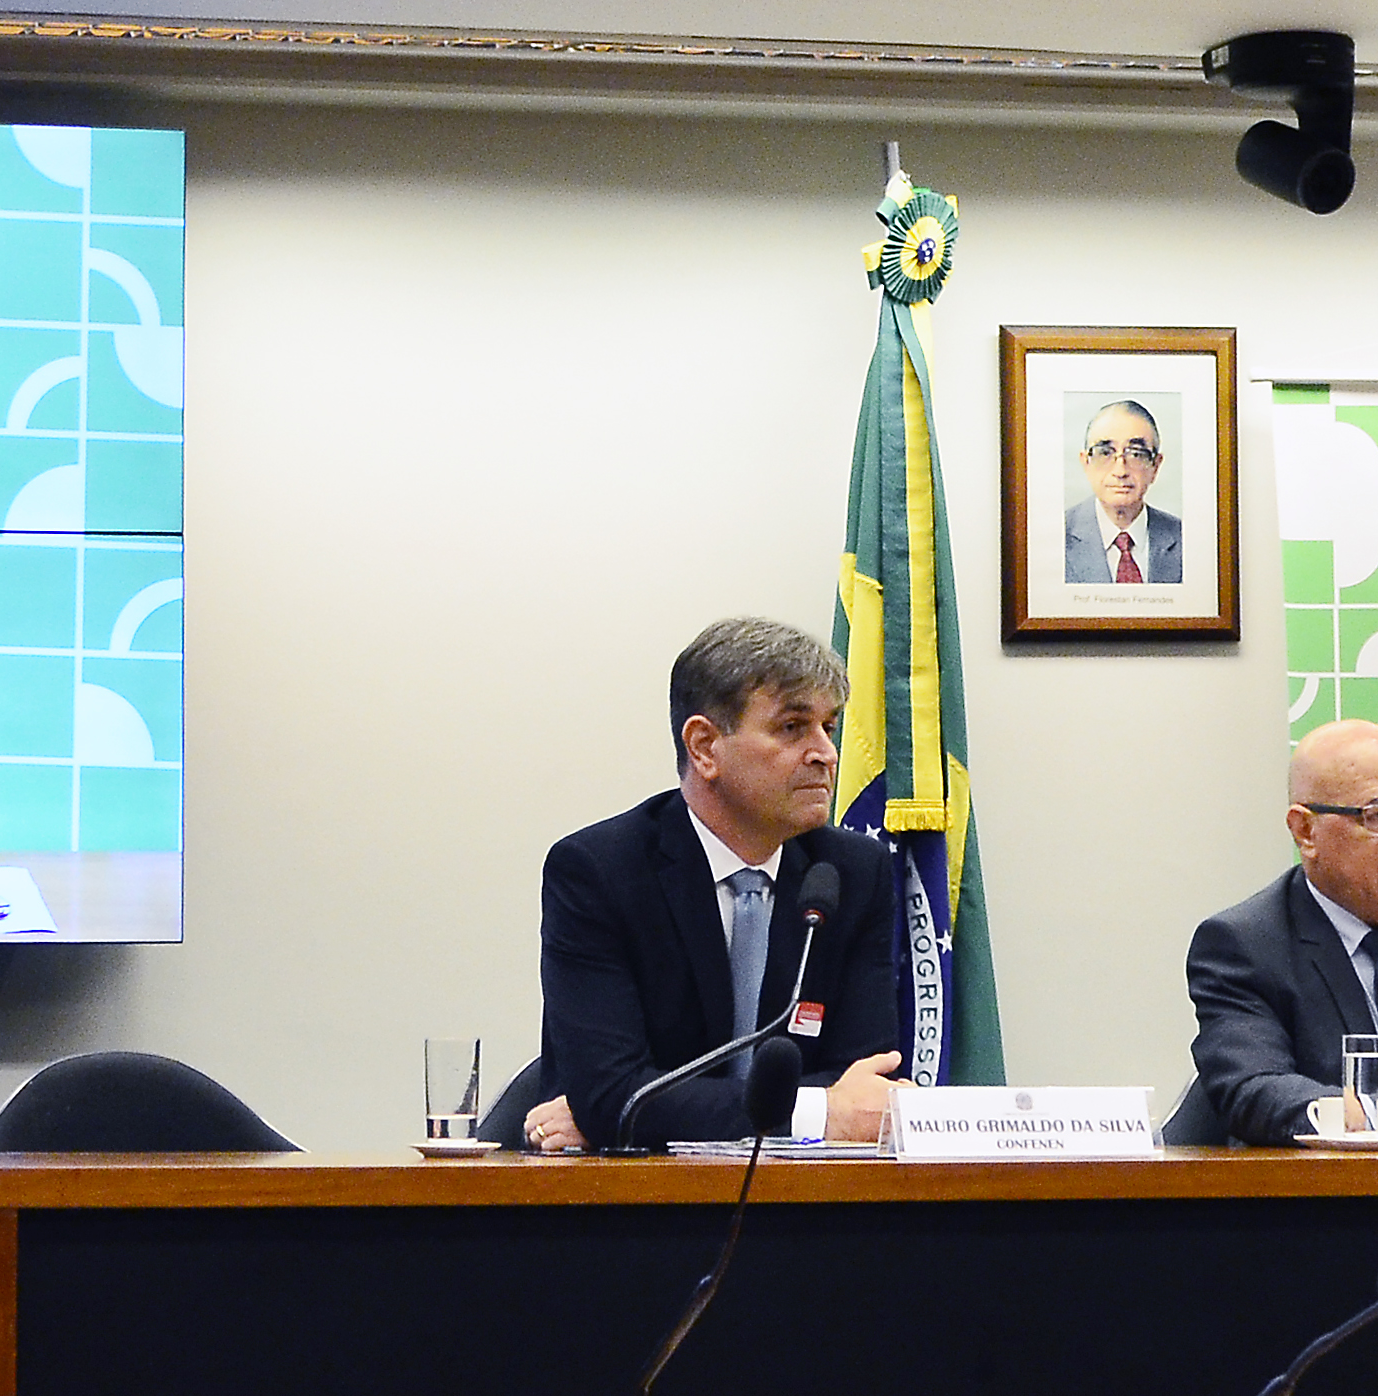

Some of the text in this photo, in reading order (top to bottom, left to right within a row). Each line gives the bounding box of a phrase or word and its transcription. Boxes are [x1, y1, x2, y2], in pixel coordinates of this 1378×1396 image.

[910, 893, 938, 1086] PROGRESSO
[909, 1119, 1146, 1133] MAURO GRIMALDO DA SILVA
[996, 1138, 1065, 1150] CONFENEN
